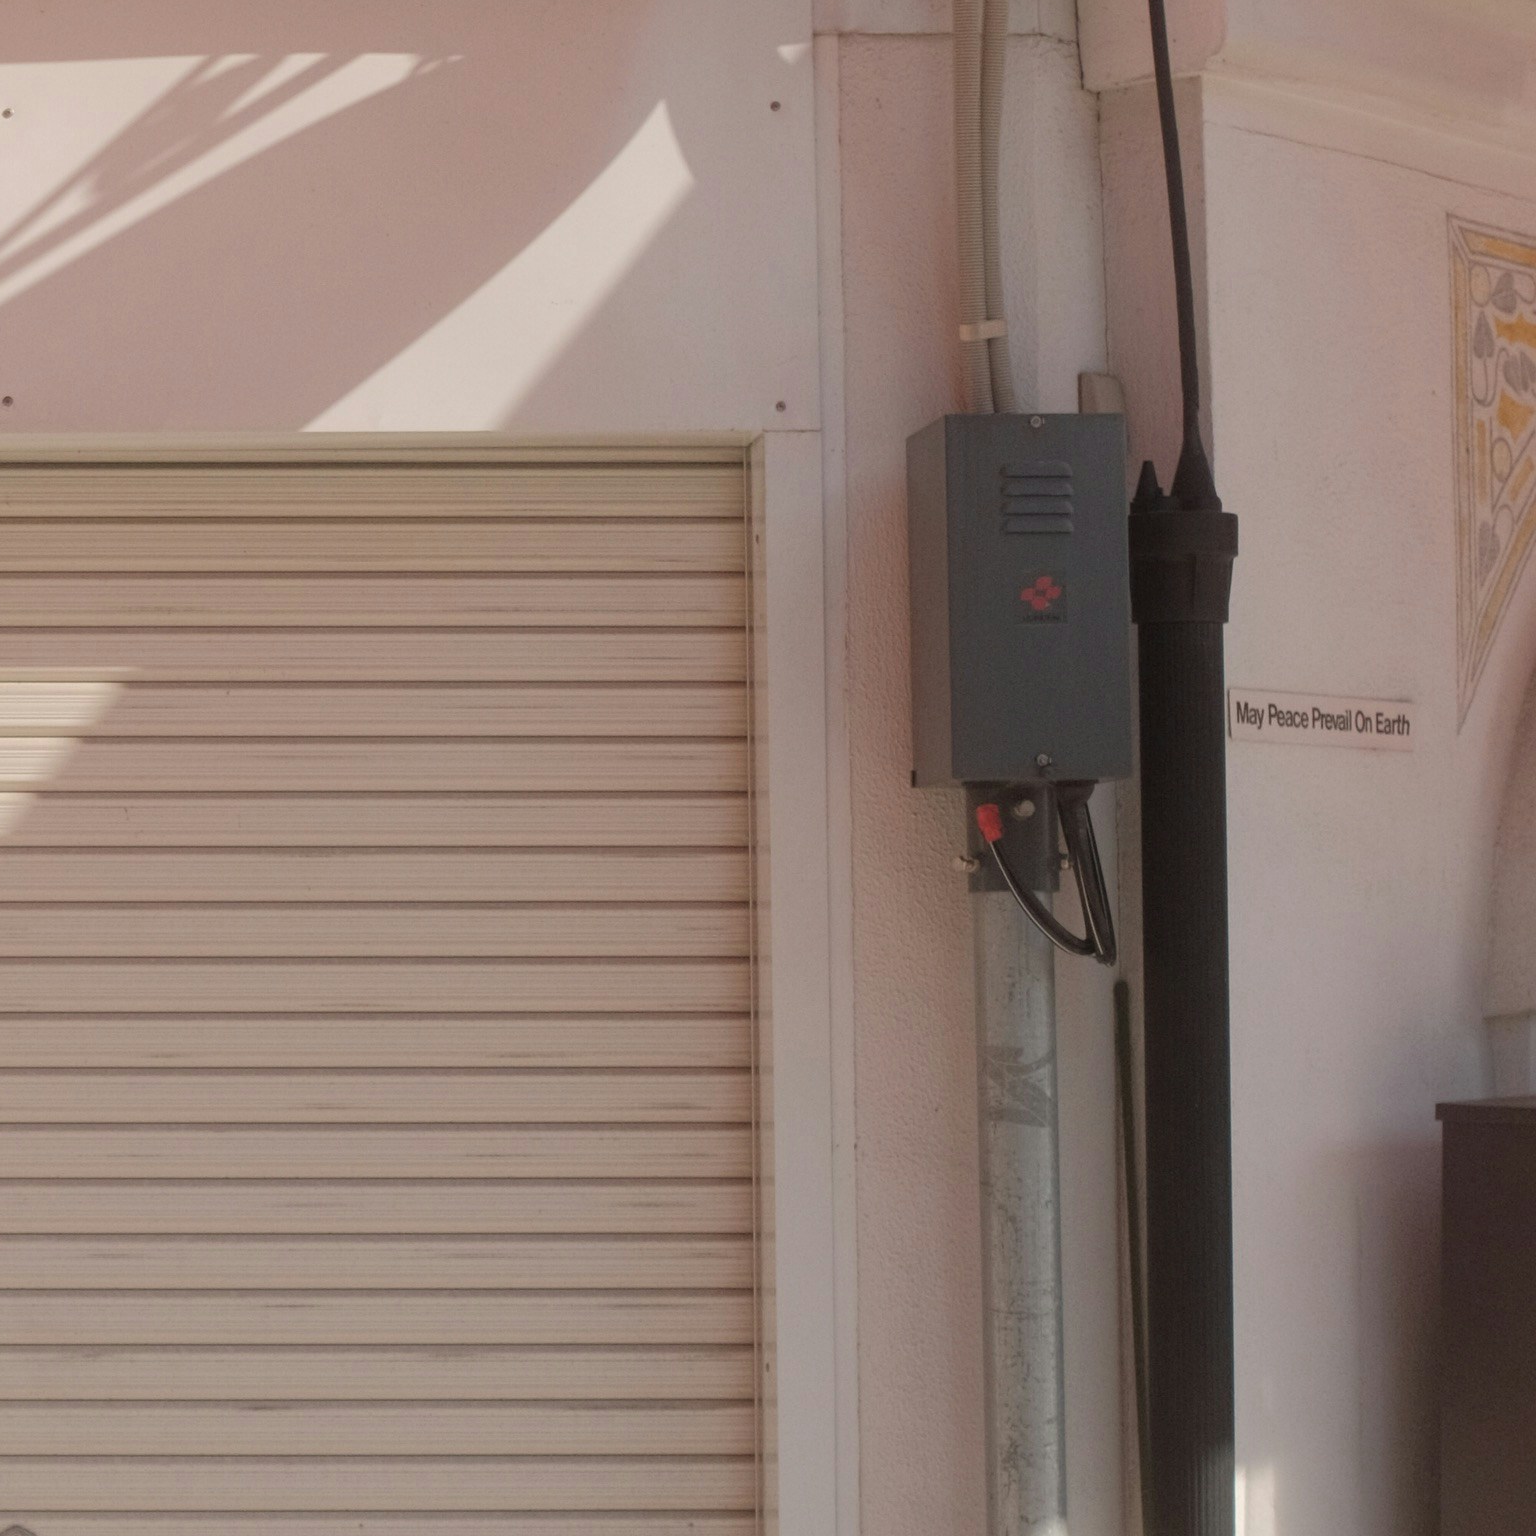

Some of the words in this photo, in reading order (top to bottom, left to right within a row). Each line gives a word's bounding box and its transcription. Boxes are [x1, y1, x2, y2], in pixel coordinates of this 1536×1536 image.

[1236, 701, 1264, 729] May
[1268, 703, 1309, 729] Peace
[1312, 707, 1352, 731] Prevail
[1355, 710, 1373, 733] On
[1376, 712, 1410, 736] Earth
